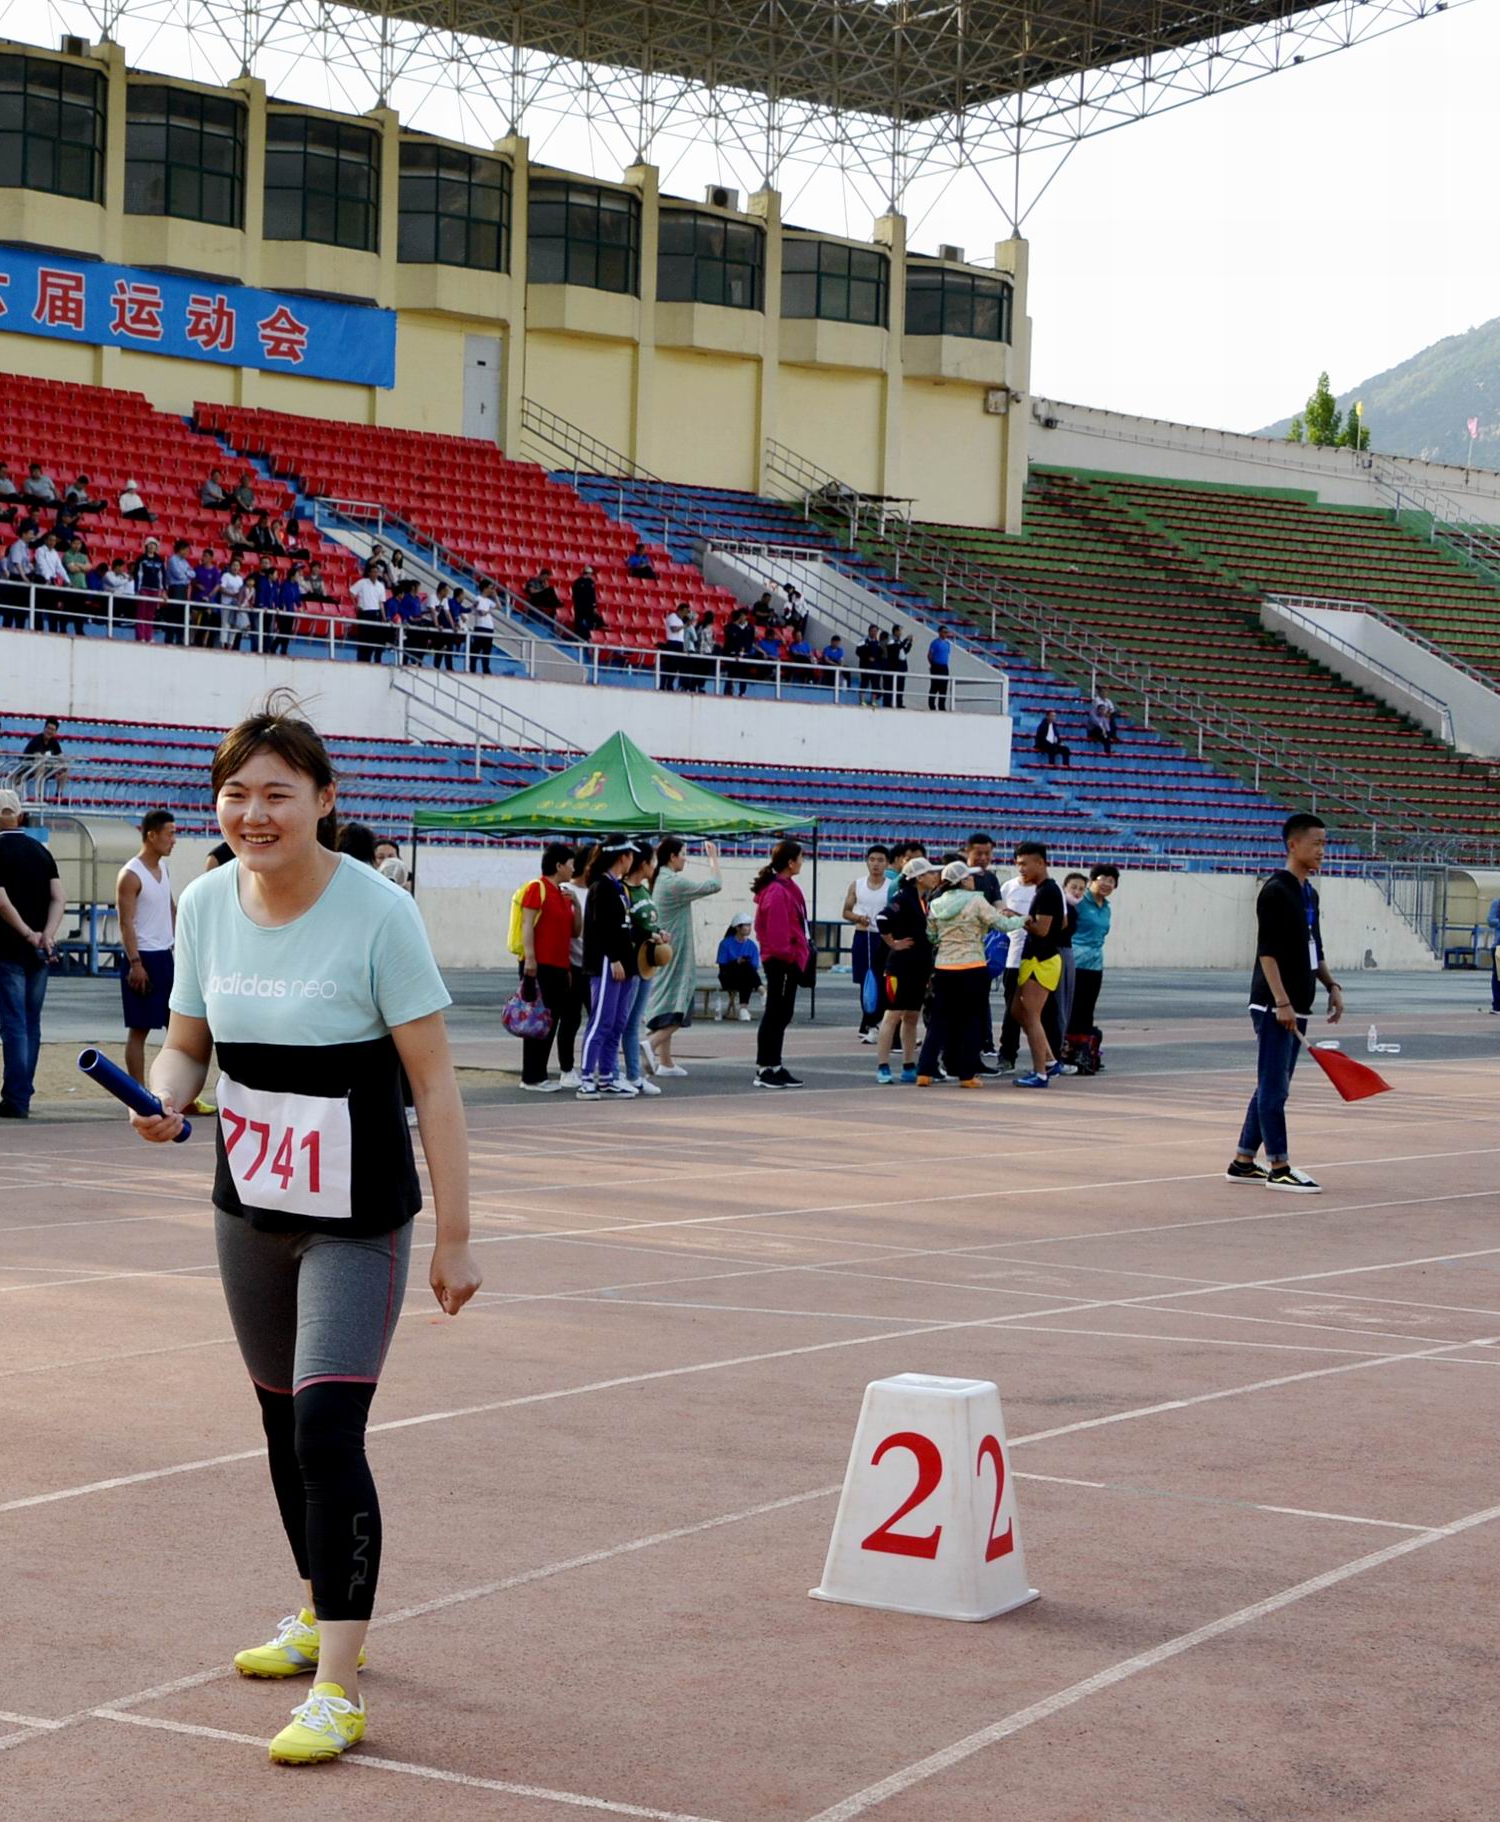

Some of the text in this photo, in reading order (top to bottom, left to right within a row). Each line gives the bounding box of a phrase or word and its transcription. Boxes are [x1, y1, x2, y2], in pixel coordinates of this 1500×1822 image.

[290, 979, 338, 999] neo
[221, 1107, 320, 1193] 7741
[861, 1431, 943, 1560] 2
[976, 1434, 1014, 1563] 2
